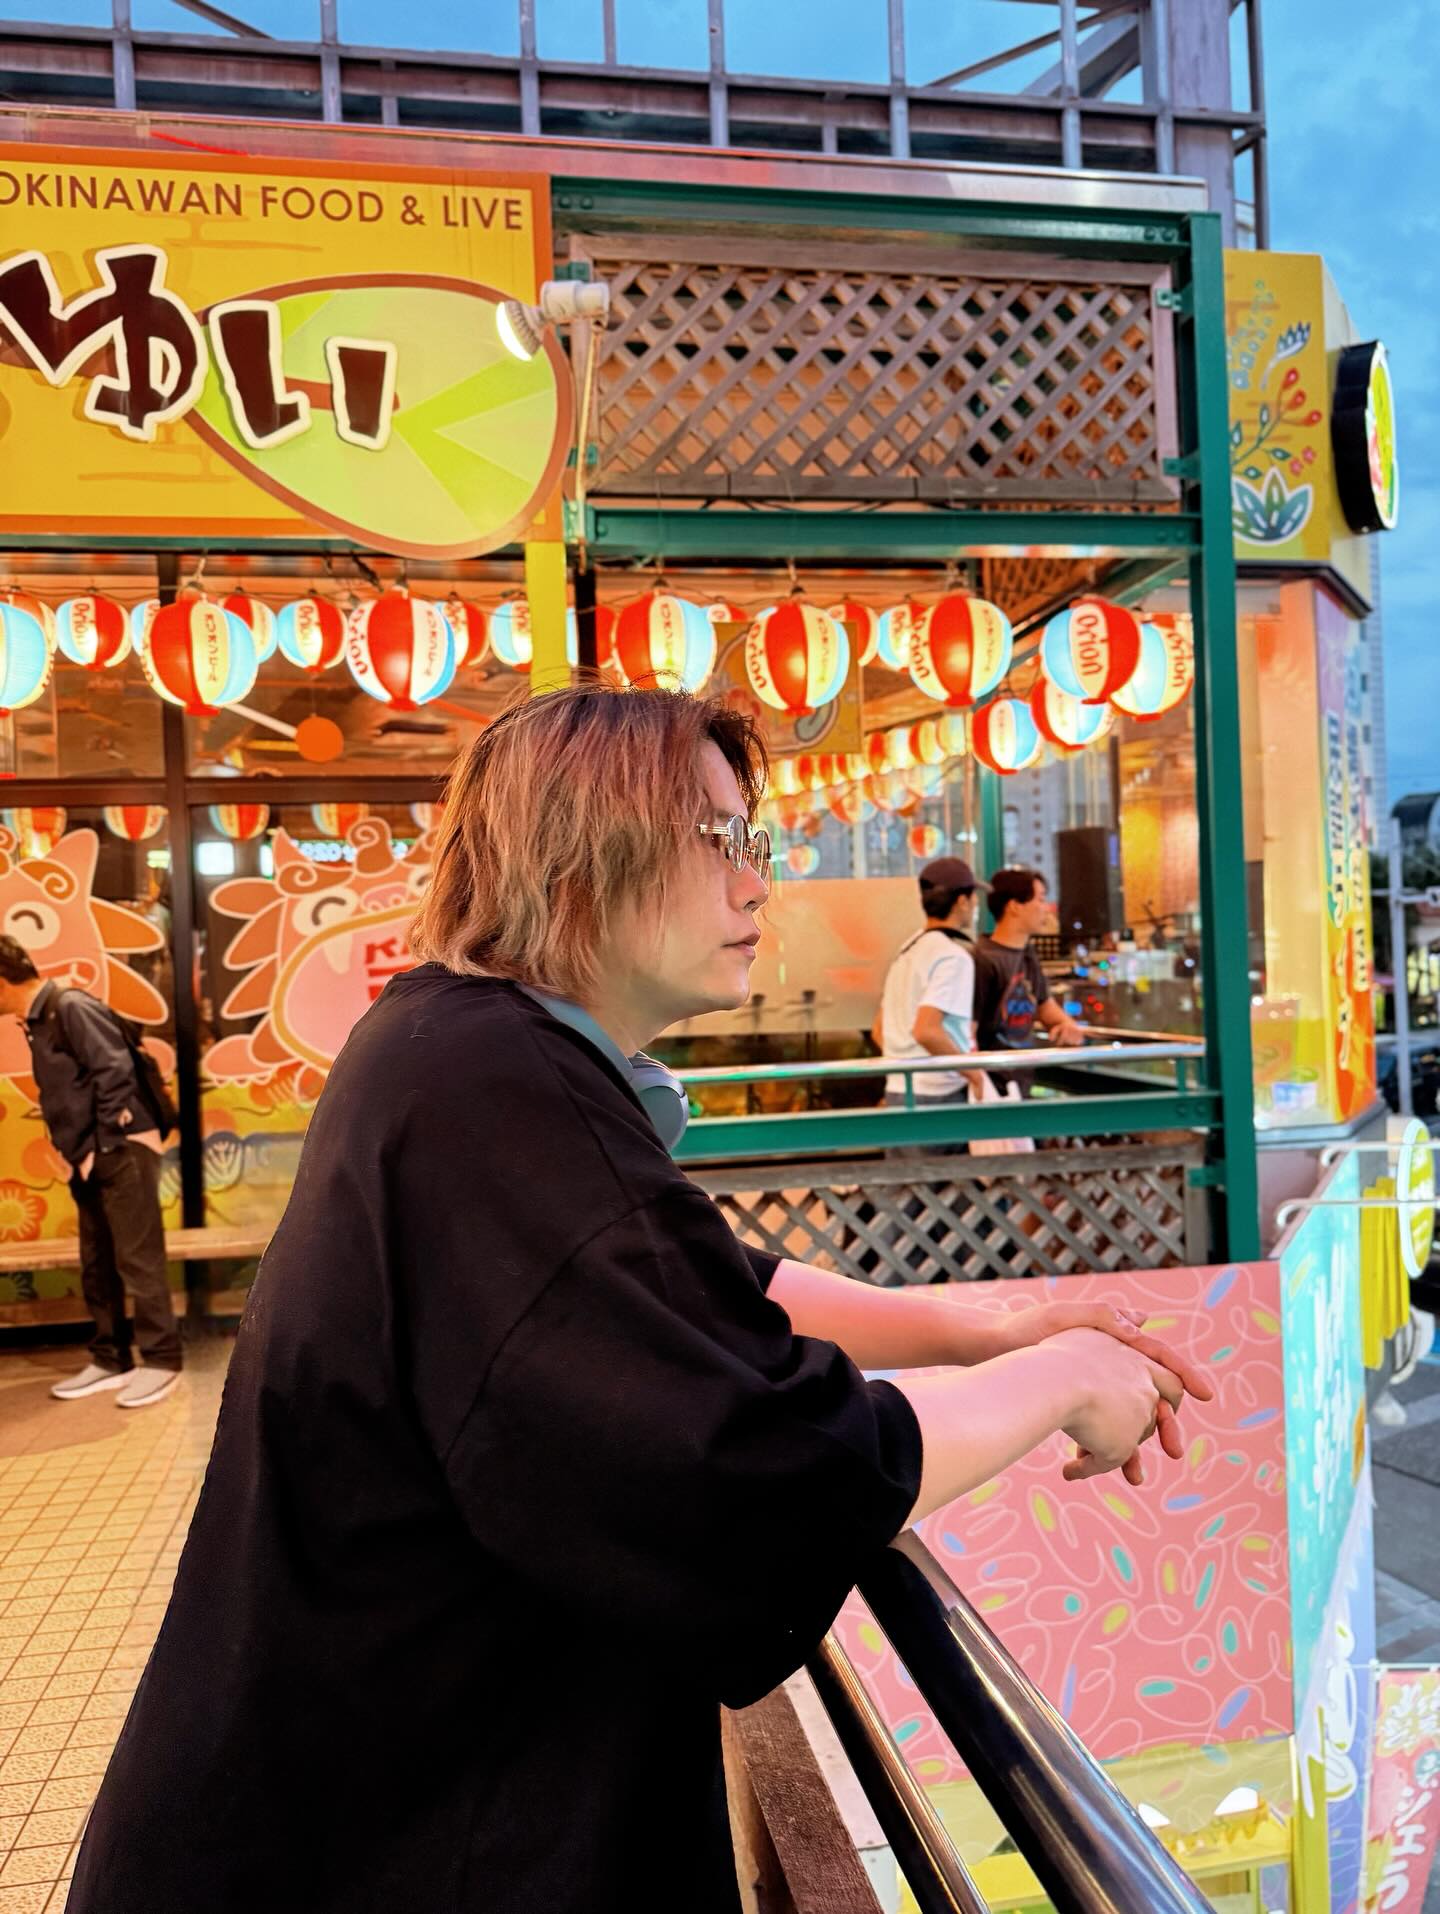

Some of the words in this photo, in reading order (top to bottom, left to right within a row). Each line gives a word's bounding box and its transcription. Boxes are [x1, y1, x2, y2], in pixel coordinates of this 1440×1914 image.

[0, 171, 242, 216] OKINAWAN
[261, 186, 384, 222] FOOD
[400, 194, 425, 225] &
[443, 196, 523, 230] LIVE
[1077, 614, 1109, 677] Orion
[1166, 632, 1193, 688] Orion
